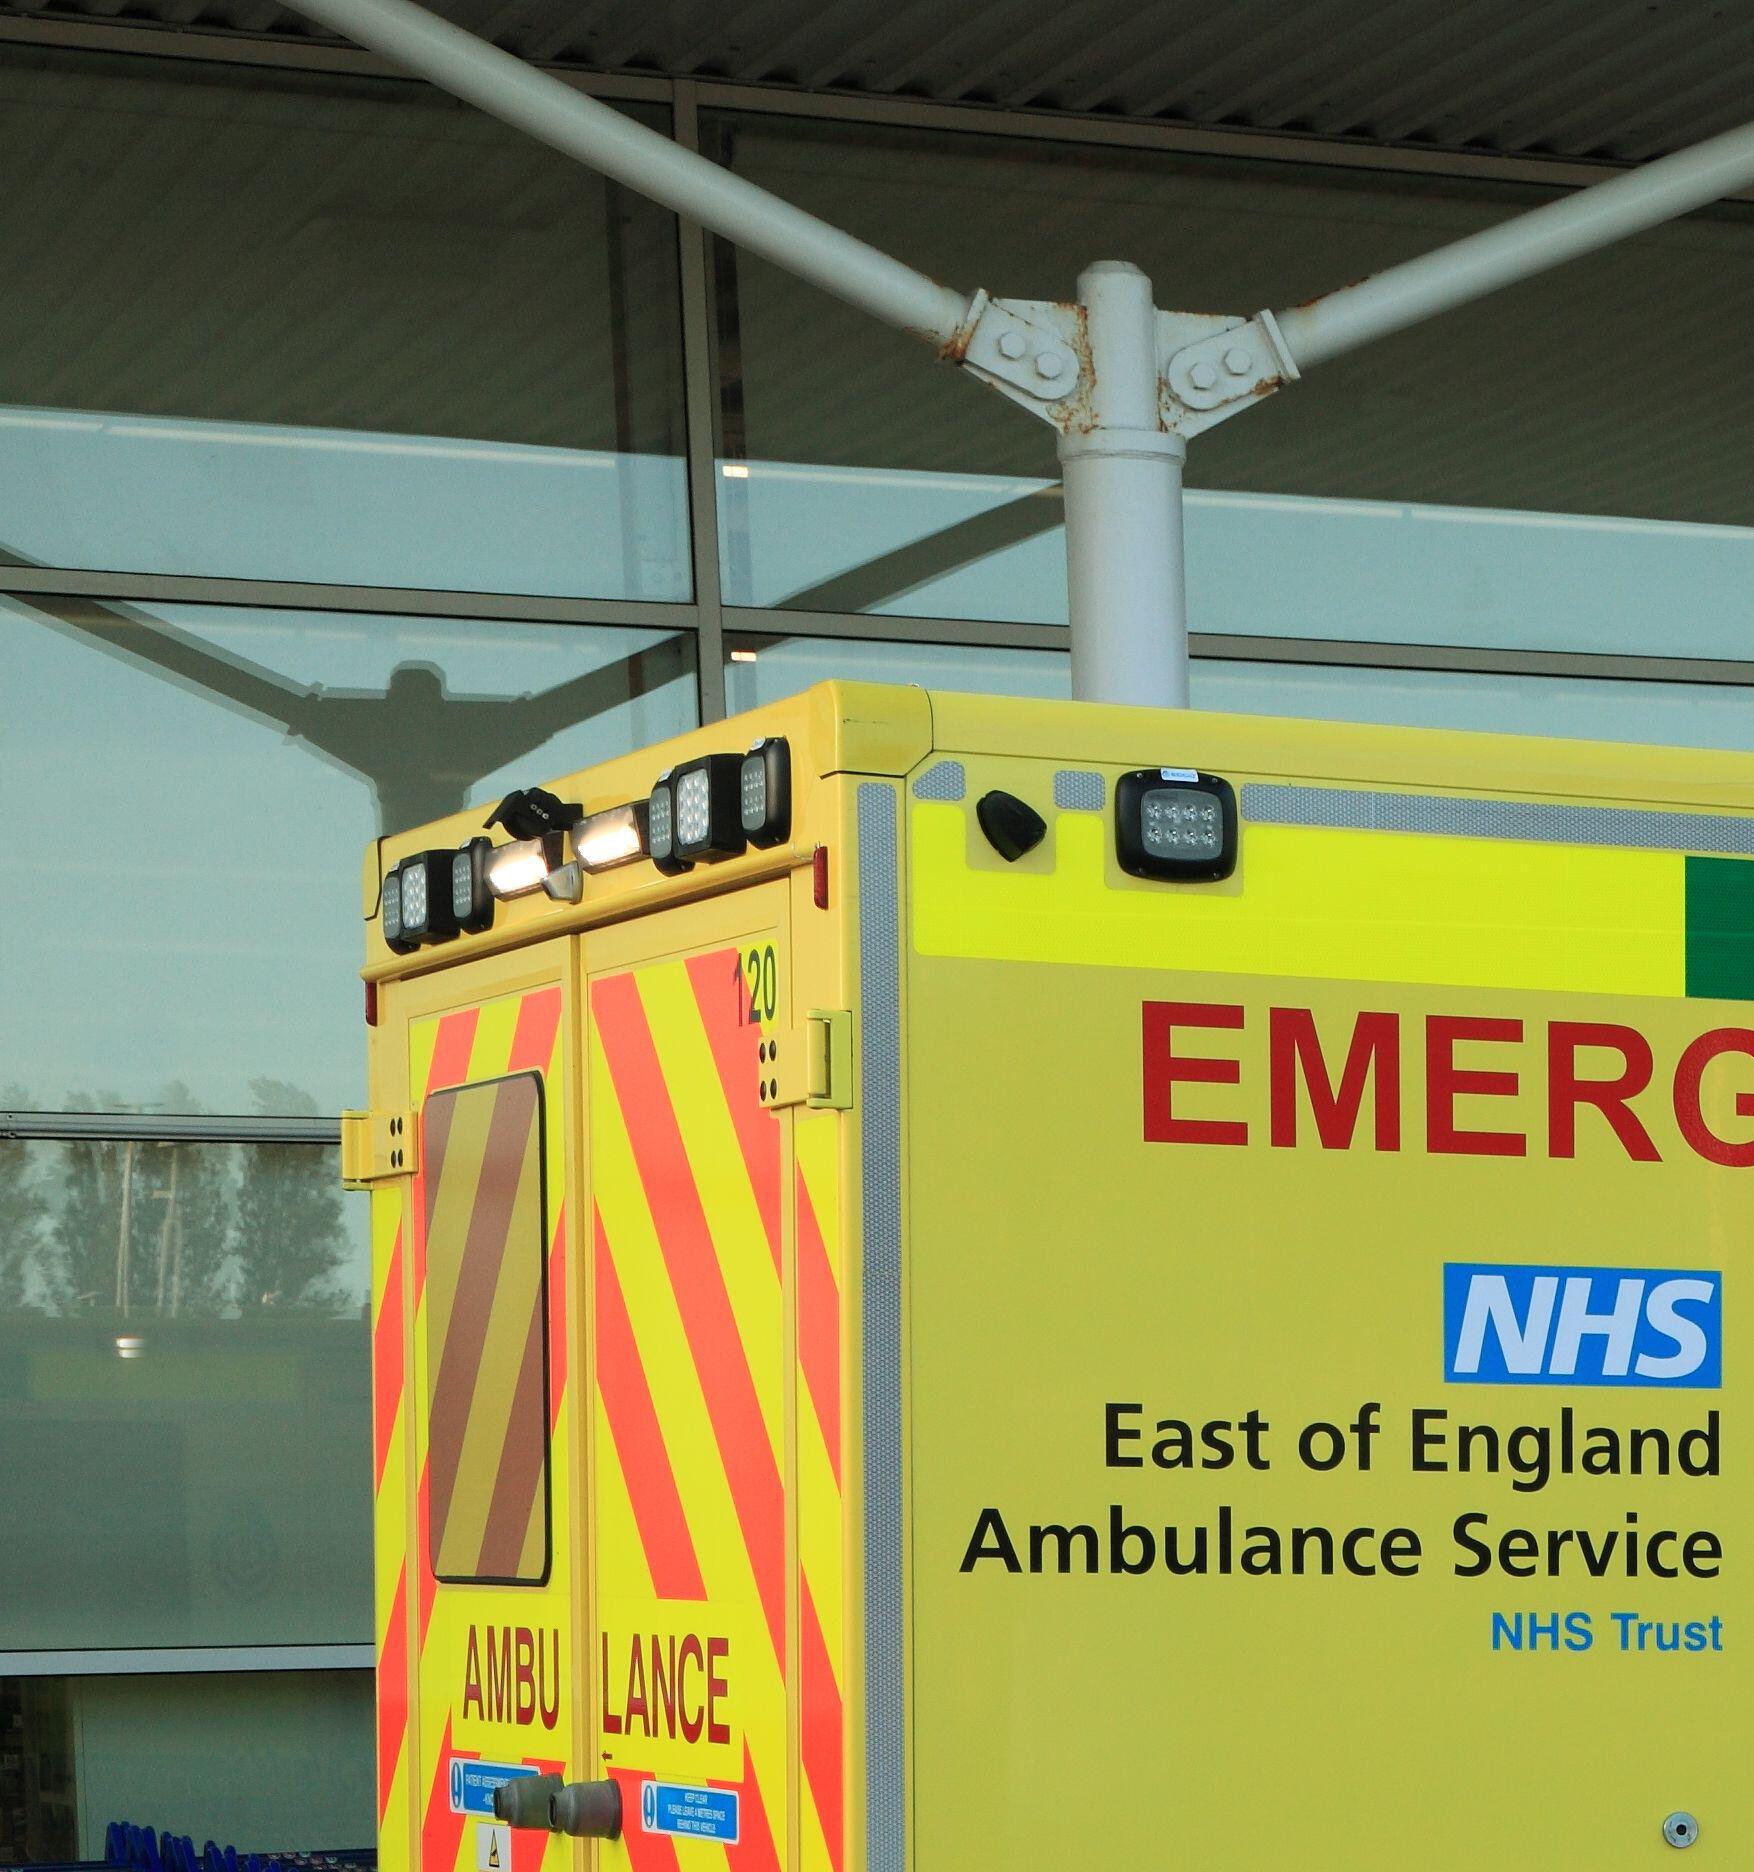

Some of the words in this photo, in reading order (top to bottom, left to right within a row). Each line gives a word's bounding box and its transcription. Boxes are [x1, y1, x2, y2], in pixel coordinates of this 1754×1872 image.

[735, 944, 778, 1028] 120
[1453, 1274, 1715, 1379] NHS
[1105, 1403, 1270, 1469] East
[1297, 1403, 1381, 1471] of
[1411, 1407, 1721, 1492] England
[959, 1505, 1422, 1576] Ambulance
[1453, 1512, 1723, 1578] Service
[1492, 1612, 1593, 1651] NHS
[1610, 1613, 1723, 1651] Trust
[462, 1624, 561, 1732] AMBU
[601, 1631, 730, 1746] LANCE
